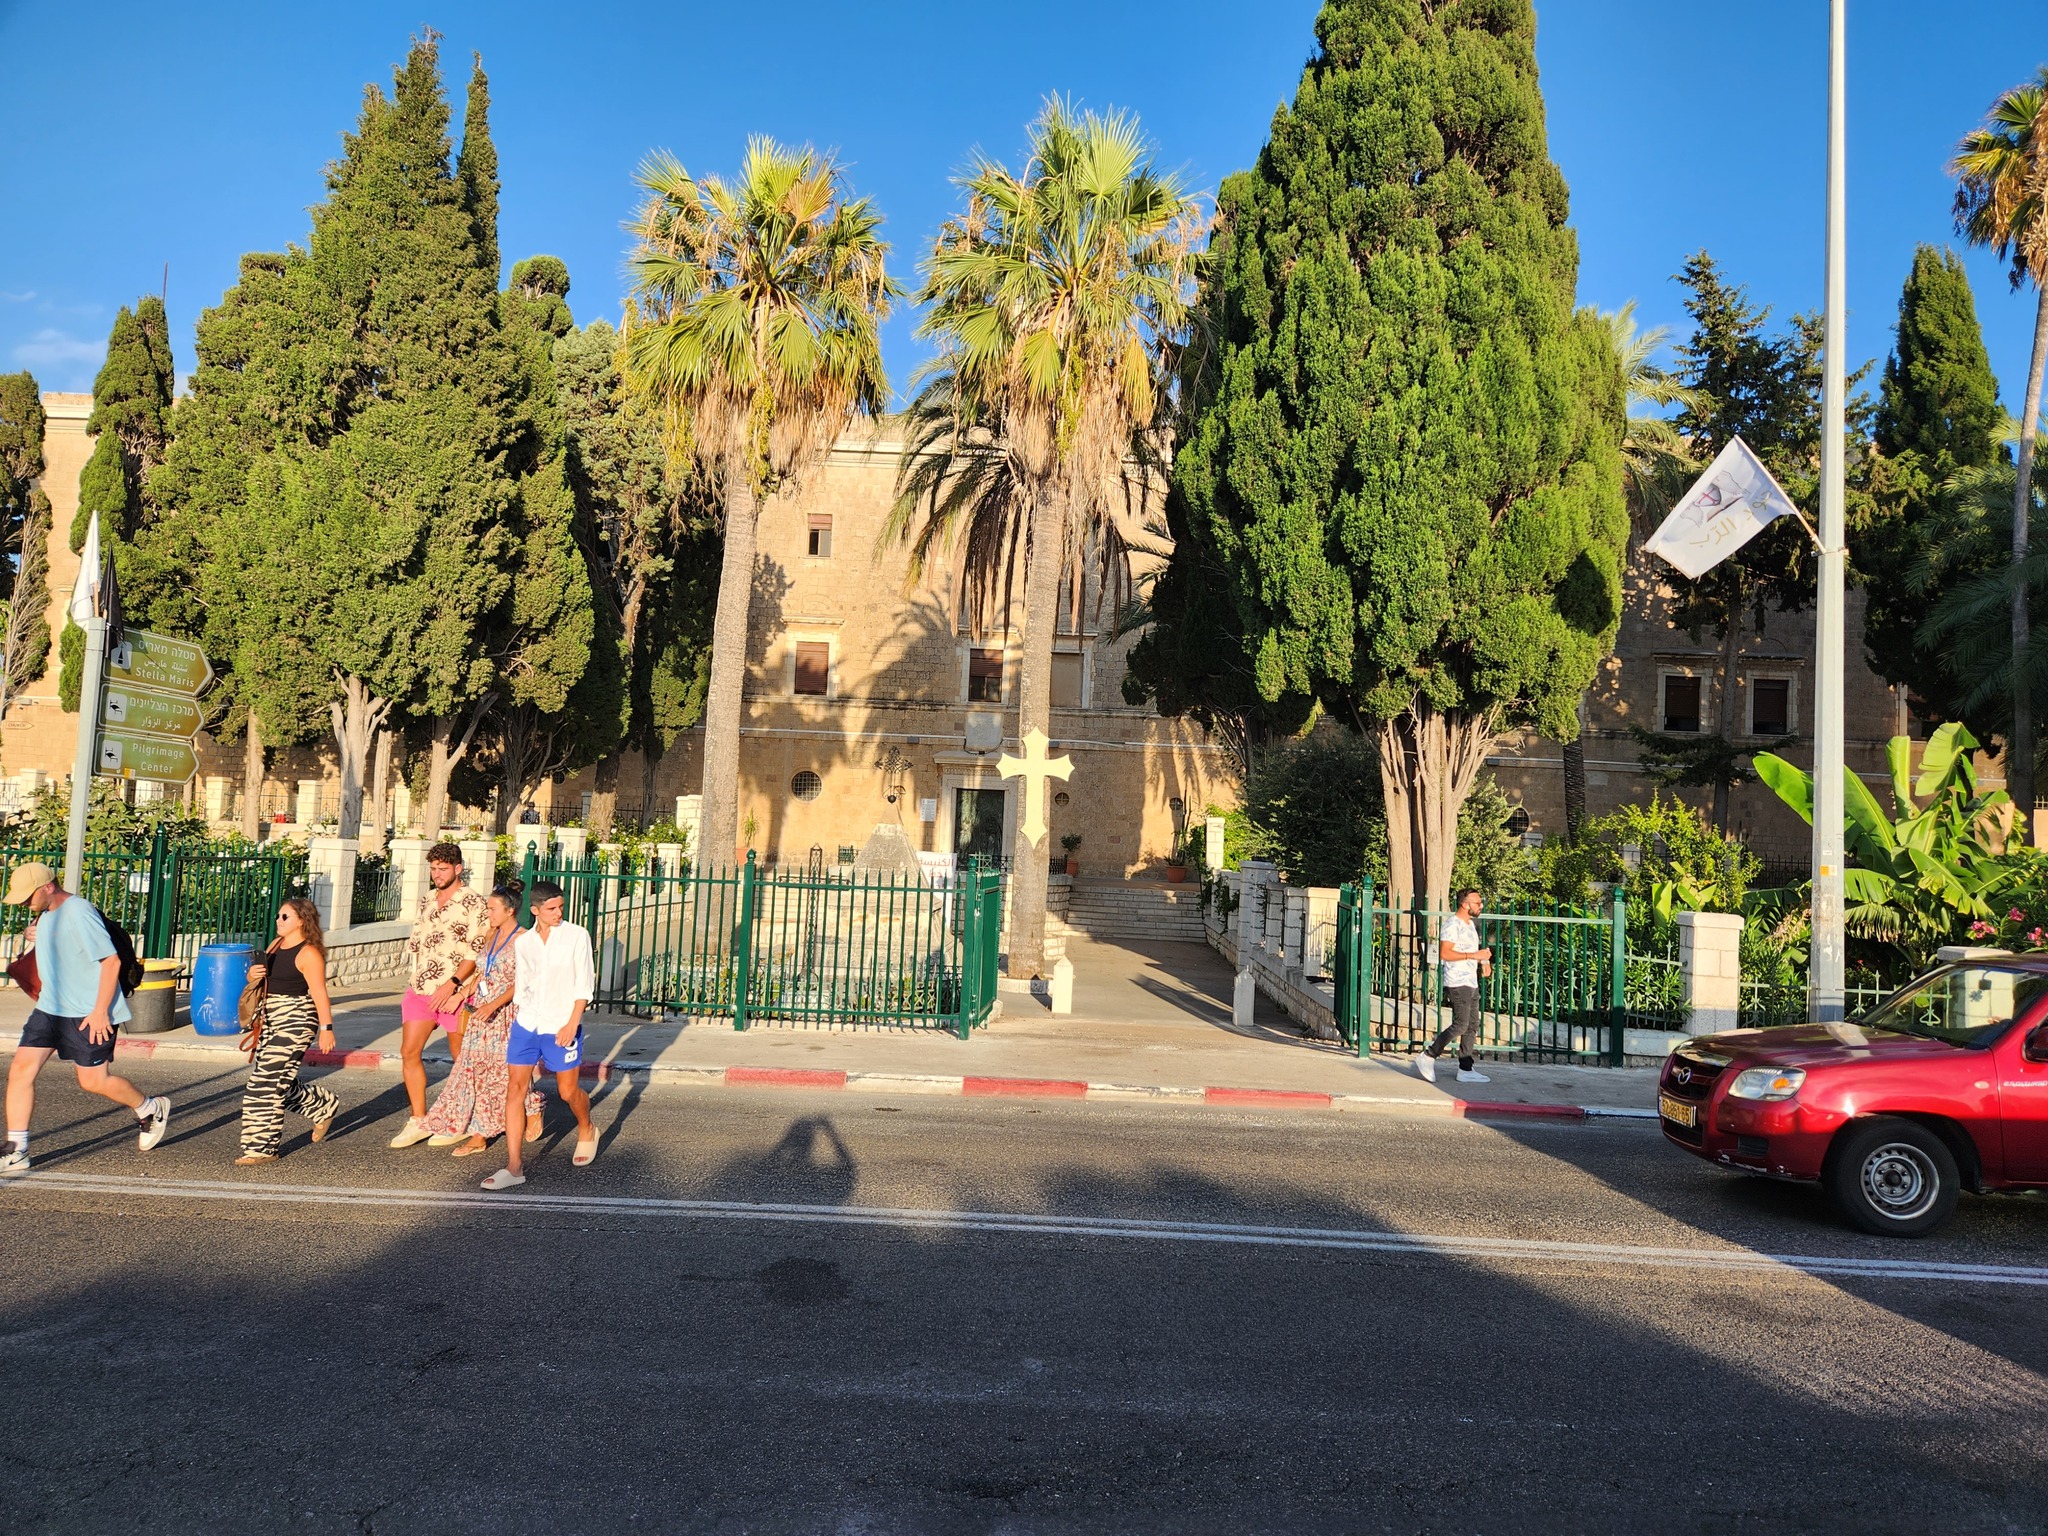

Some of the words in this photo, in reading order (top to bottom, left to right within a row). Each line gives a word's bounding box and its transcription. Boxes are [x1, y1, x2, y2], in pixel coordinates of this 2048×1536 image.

[139, 640, 168, 655] מאריס
[171, 647, 196, 661] סטלה
[136, 667, 166, 681] Stella
[169, 674, 195, 687] Maris
[129, 697, 169, 712] הצליינים
[172, 704, 194, 717] מרכז
[164, 720, 181, 731] مركز
[132, 743, 184, 759] Pilgrimage
[140, 761, 174, 774] Center
